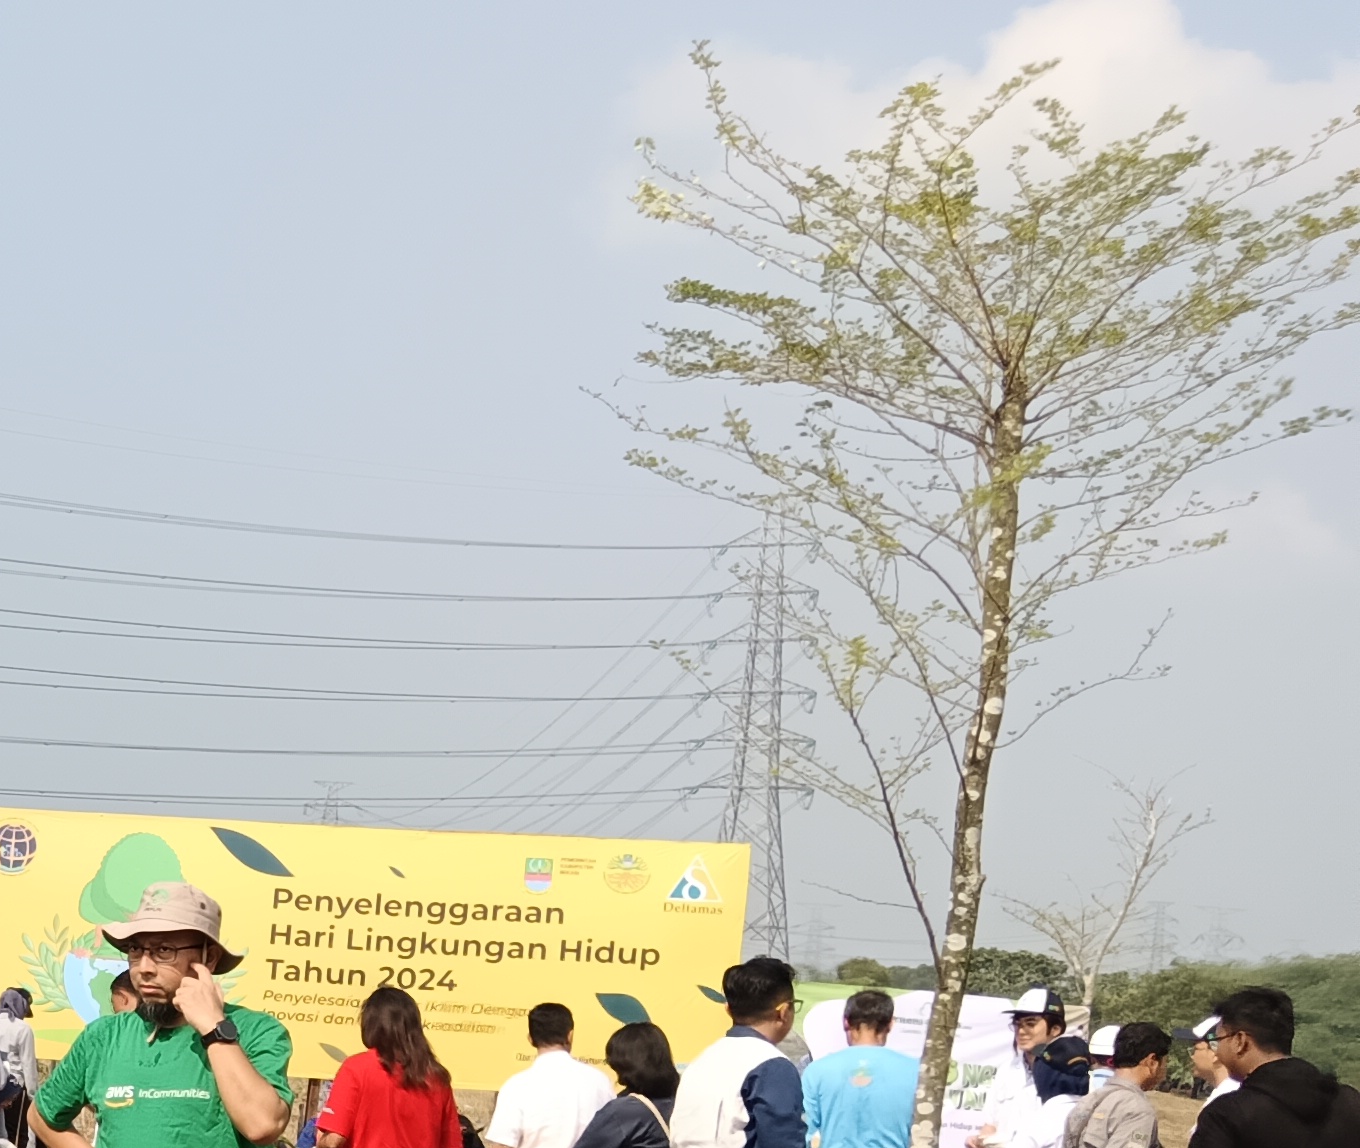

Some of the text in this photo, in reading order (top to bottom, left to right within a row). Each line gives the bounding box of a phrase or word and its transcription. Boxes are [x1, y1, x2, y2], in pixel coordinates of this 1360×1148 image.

[272, 887, 565, 926] Penyelenggaraan
[663, 902, 723, 915] Deltamas
[269, 923, 661, 971] Hari Lingkungan Hidup
[265, 958, 458, 992] Tahun 2024
[262, 989, 362, 1008] Penyelesaia
[105, 1086, 211, 1099] aws InCommunities
